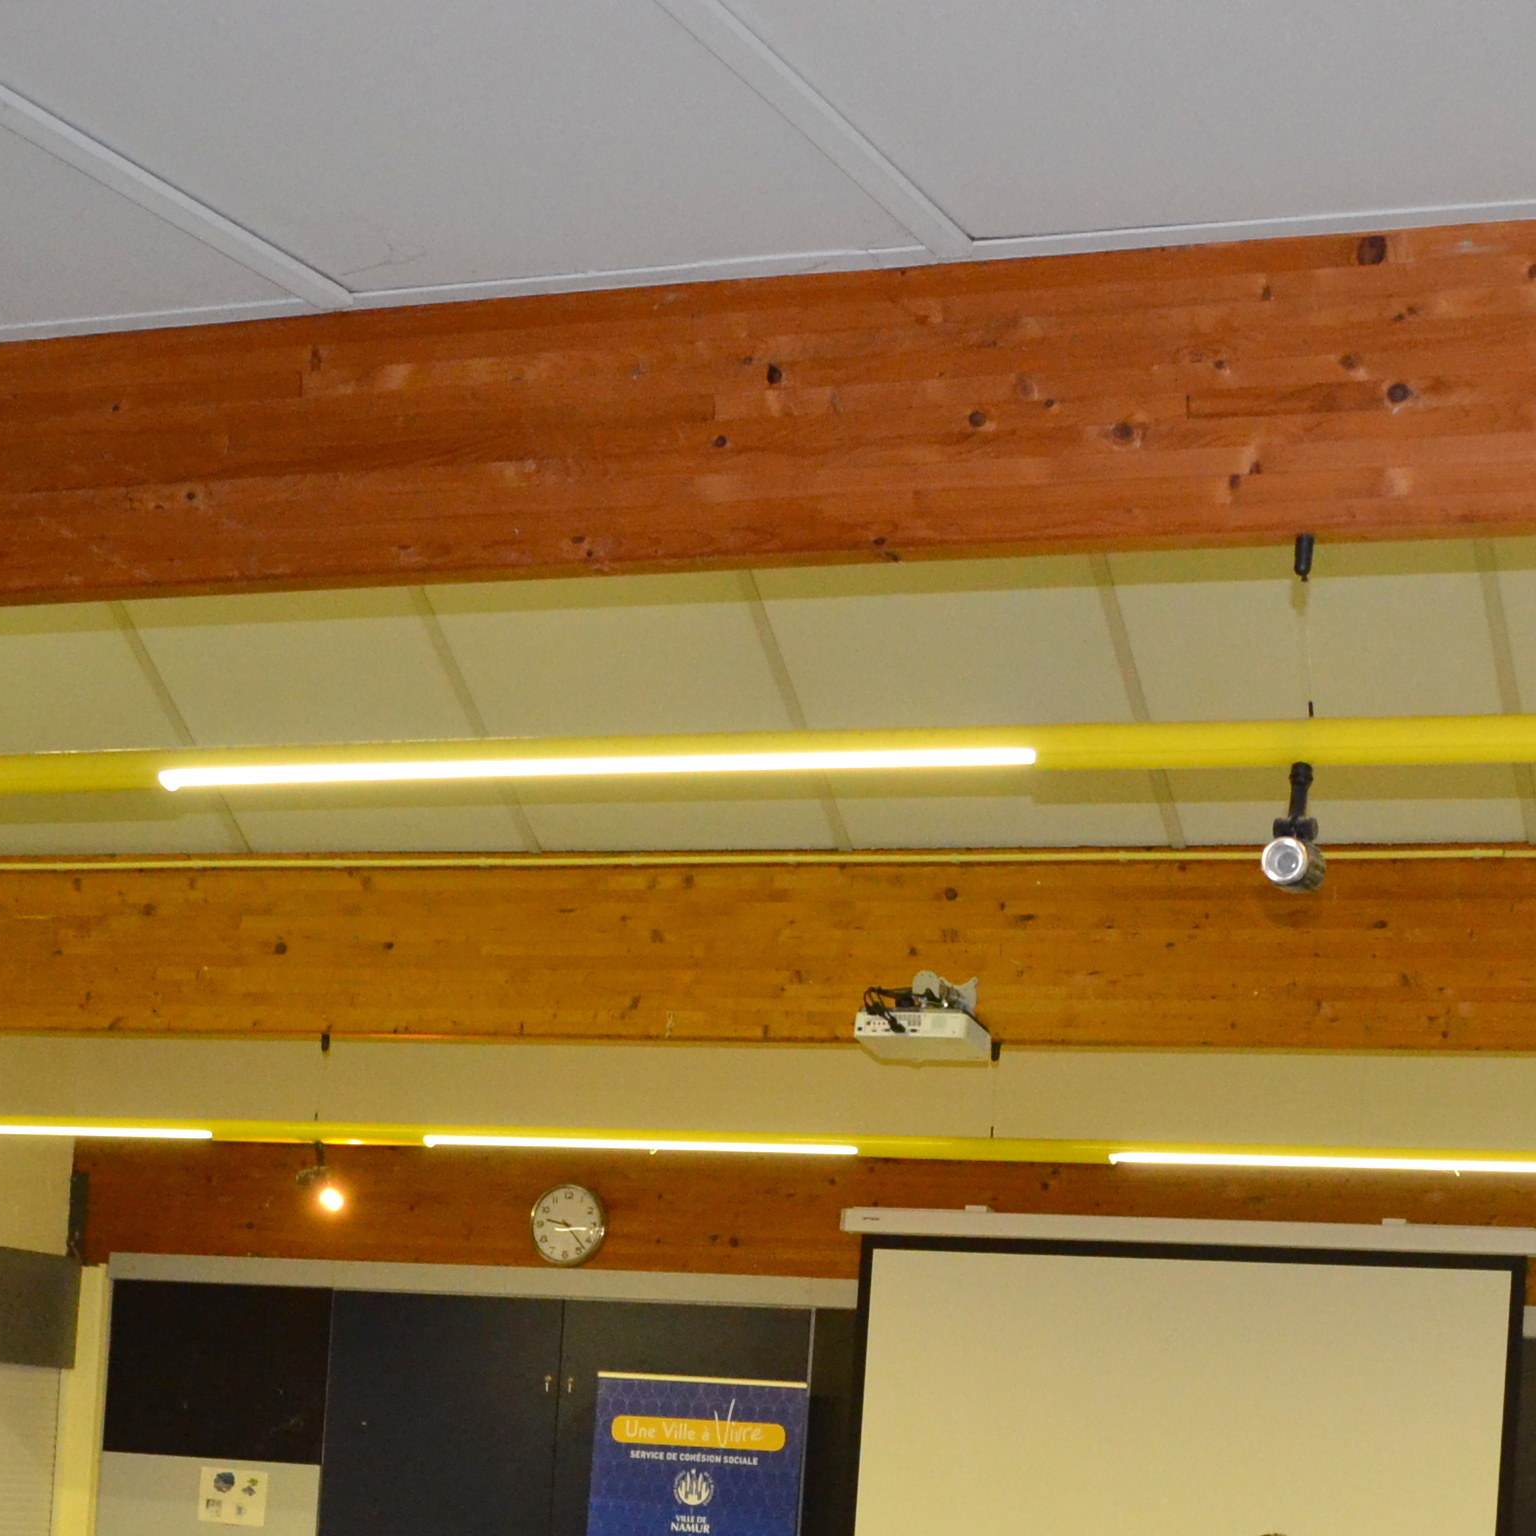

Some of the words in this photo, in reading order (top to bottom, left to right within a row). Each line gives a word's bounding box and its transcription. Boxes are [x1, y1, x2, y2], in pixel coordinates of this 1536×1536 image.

[625, 1419, 656, 1438] Une
[663, 1421, 695, 1441] Ville
[702, 1425, 711, 1442] à
[714, 1398, 764, 1448] Vivre
[630, 1450, 664, 1461] SERVICE
[666, 1451, 677, 1461] DE
[679, 1451, 722, 1463] COHÉSION
[723, 1454, 759, 1466] SOCIALE
[675, 1514, 695, 1523] VILLE
[696, 1515, 707, 1523] DE
[670, 1521, 711, 1534] NAMUR
